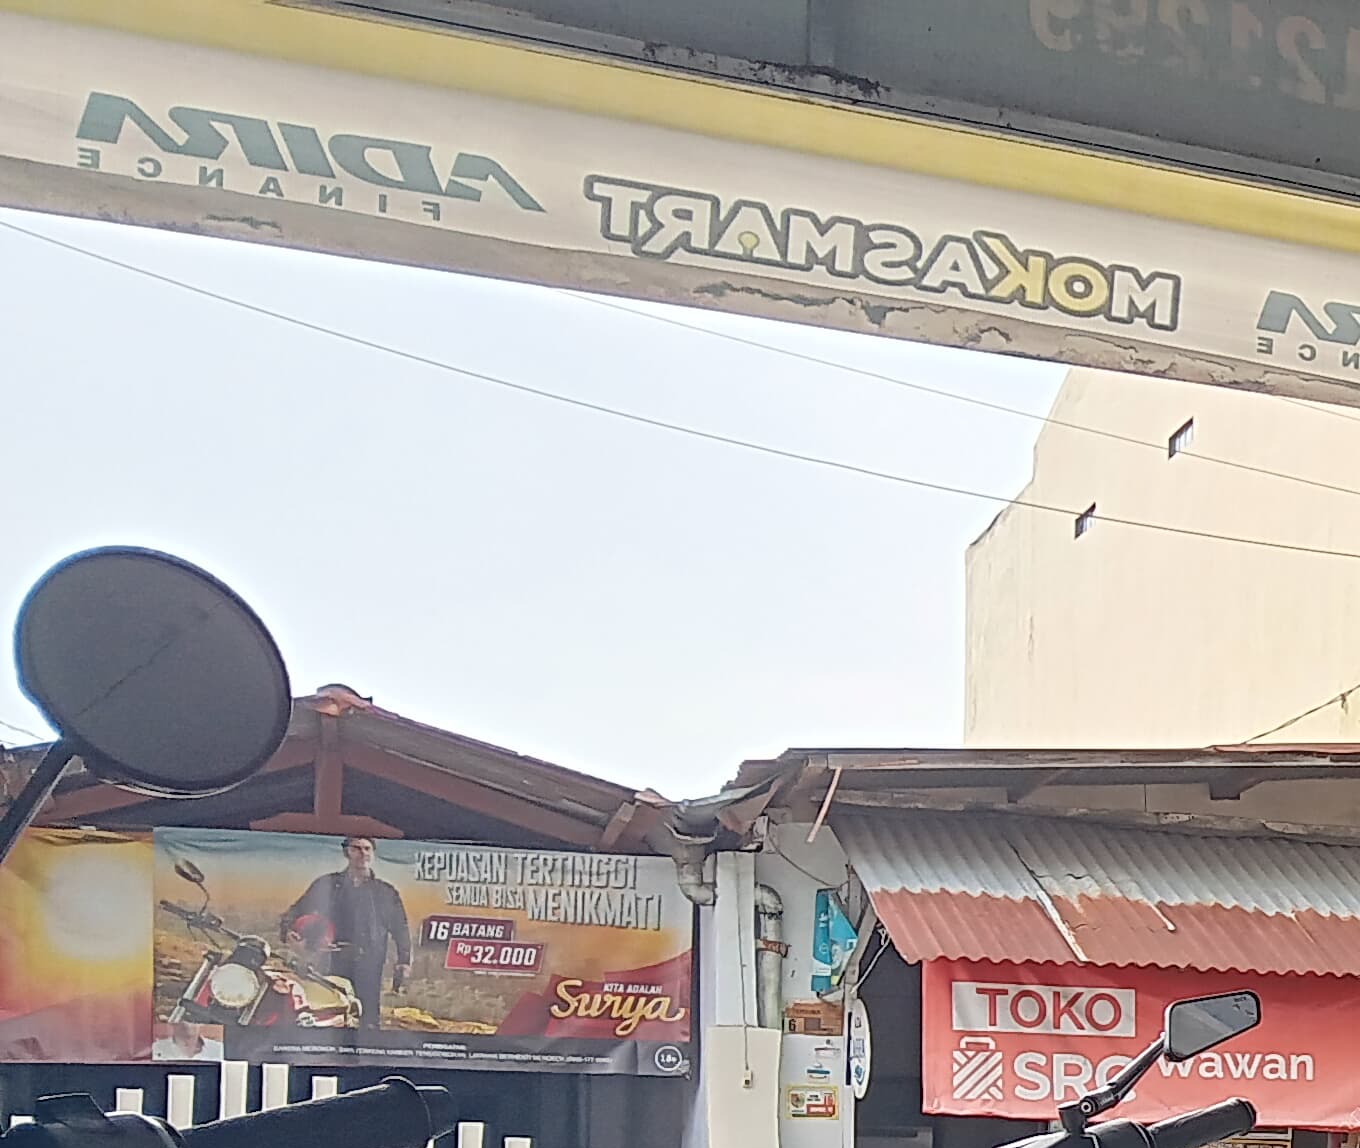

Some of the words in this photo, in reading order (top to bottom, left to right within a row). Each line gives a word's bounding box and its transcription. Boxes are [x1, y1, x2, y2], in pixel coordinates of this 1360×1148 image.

[414, 851, 507, 885] KEPUASAN
[513, 853, 638, 890] TERTINGGI
[445, 884, 491, 908] SEMUA
[526, 886, 662, 931] MENIKMATI
[428, 920, 449, 941] 16
[452, 922, 505, 939] BATANG
[550, 979, 686, 1037] Surya
[976, 987, 1122, 1031] TOKO
